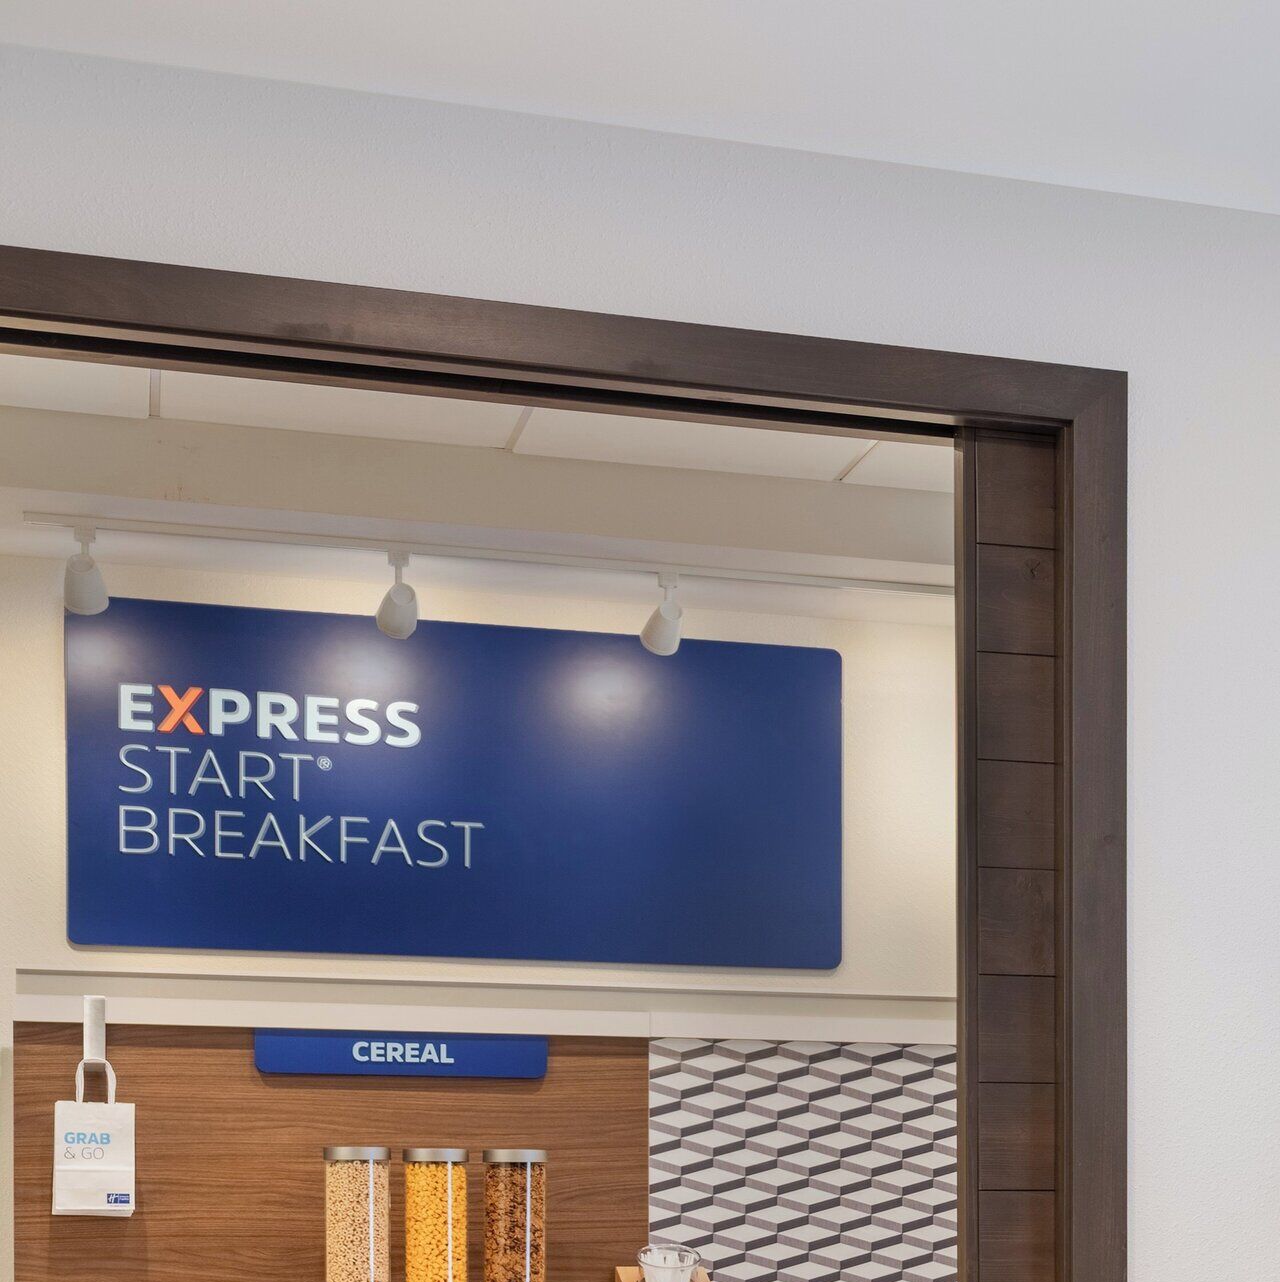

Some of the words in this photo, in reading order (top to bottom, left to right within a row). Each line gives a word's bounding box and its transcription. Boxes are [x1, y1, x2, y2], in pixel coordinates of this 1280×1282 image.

[118, 683, 421, 747] EXPRESS
[119, 805, 485, 869] BREAKFAST
[352, 1041, 455, 1064] CEREAL
[64, 1132, 111, 1145] GRAB
[64, 1147, 76, 1160] &
[81, 1147, 105, 1160] GO
